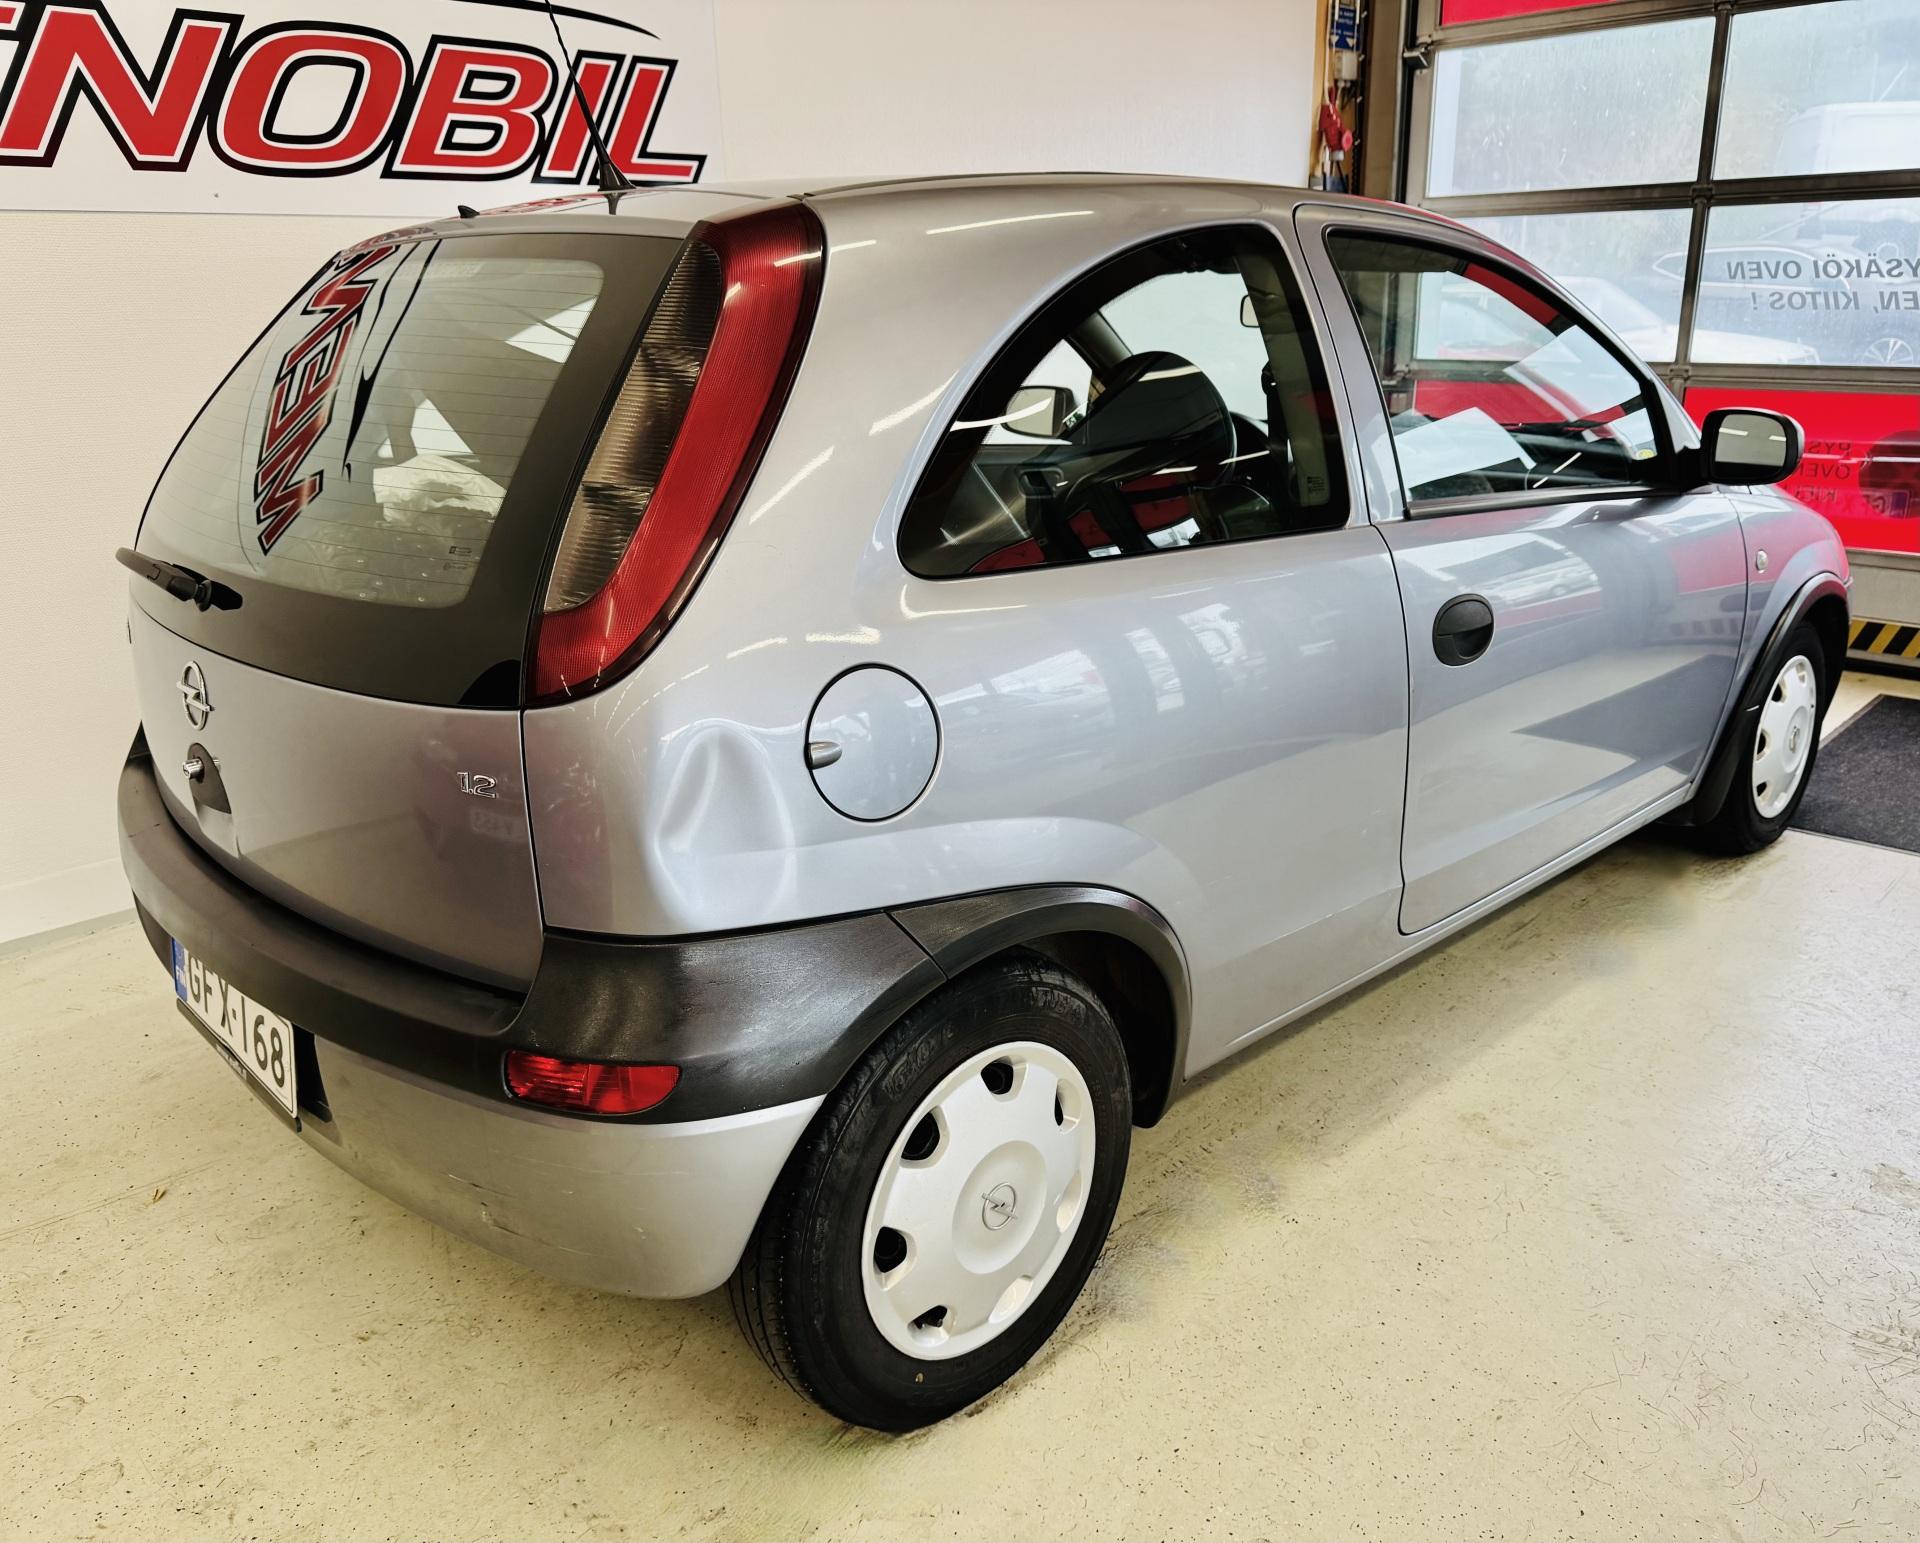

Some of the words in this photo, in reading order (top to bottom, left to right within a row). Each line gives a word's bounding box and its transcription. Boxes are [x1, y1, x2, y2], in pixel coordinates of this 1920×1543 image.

[0, 0, 707, 186] NOBIL
[456, 771, 496, 799] 1.2
[188, 951, 285, 1088] GFX-168
